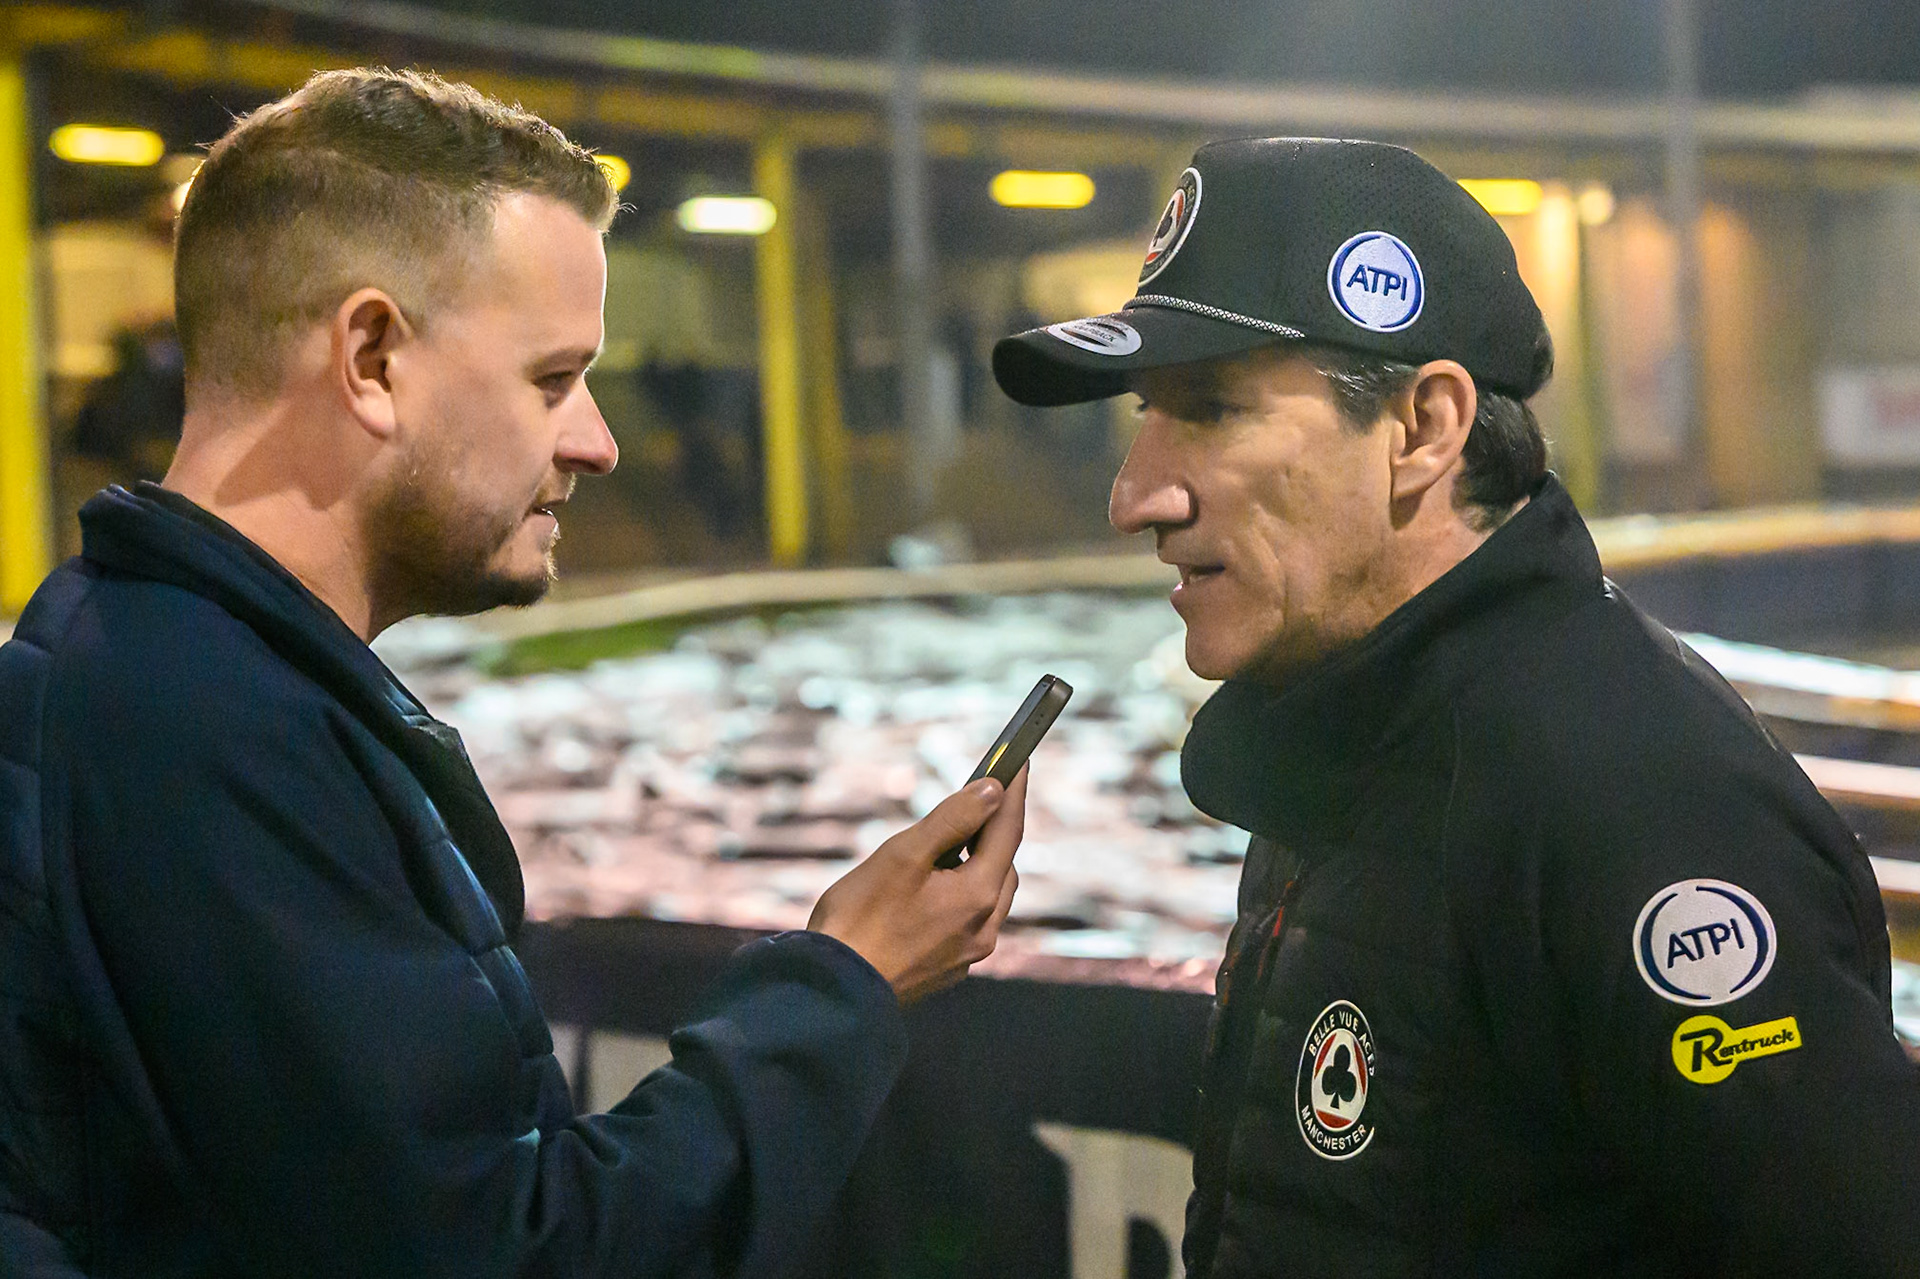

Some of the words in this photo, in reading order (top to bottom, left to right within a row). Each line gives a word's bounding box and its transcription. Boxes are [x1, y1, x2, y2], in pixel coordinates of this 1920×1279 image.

[1346, 264, 1408, 302] ATPI
[1667, 918, 1746, 969] ATPI
[1308, 1013, 1336, 1057] BELLE
[1338, 1010, 1359, 1033] VUE
[1679, 1027, 1796, 1073] Rentruck
[1301, 1104, 1367, 1151] MANCHESTER
